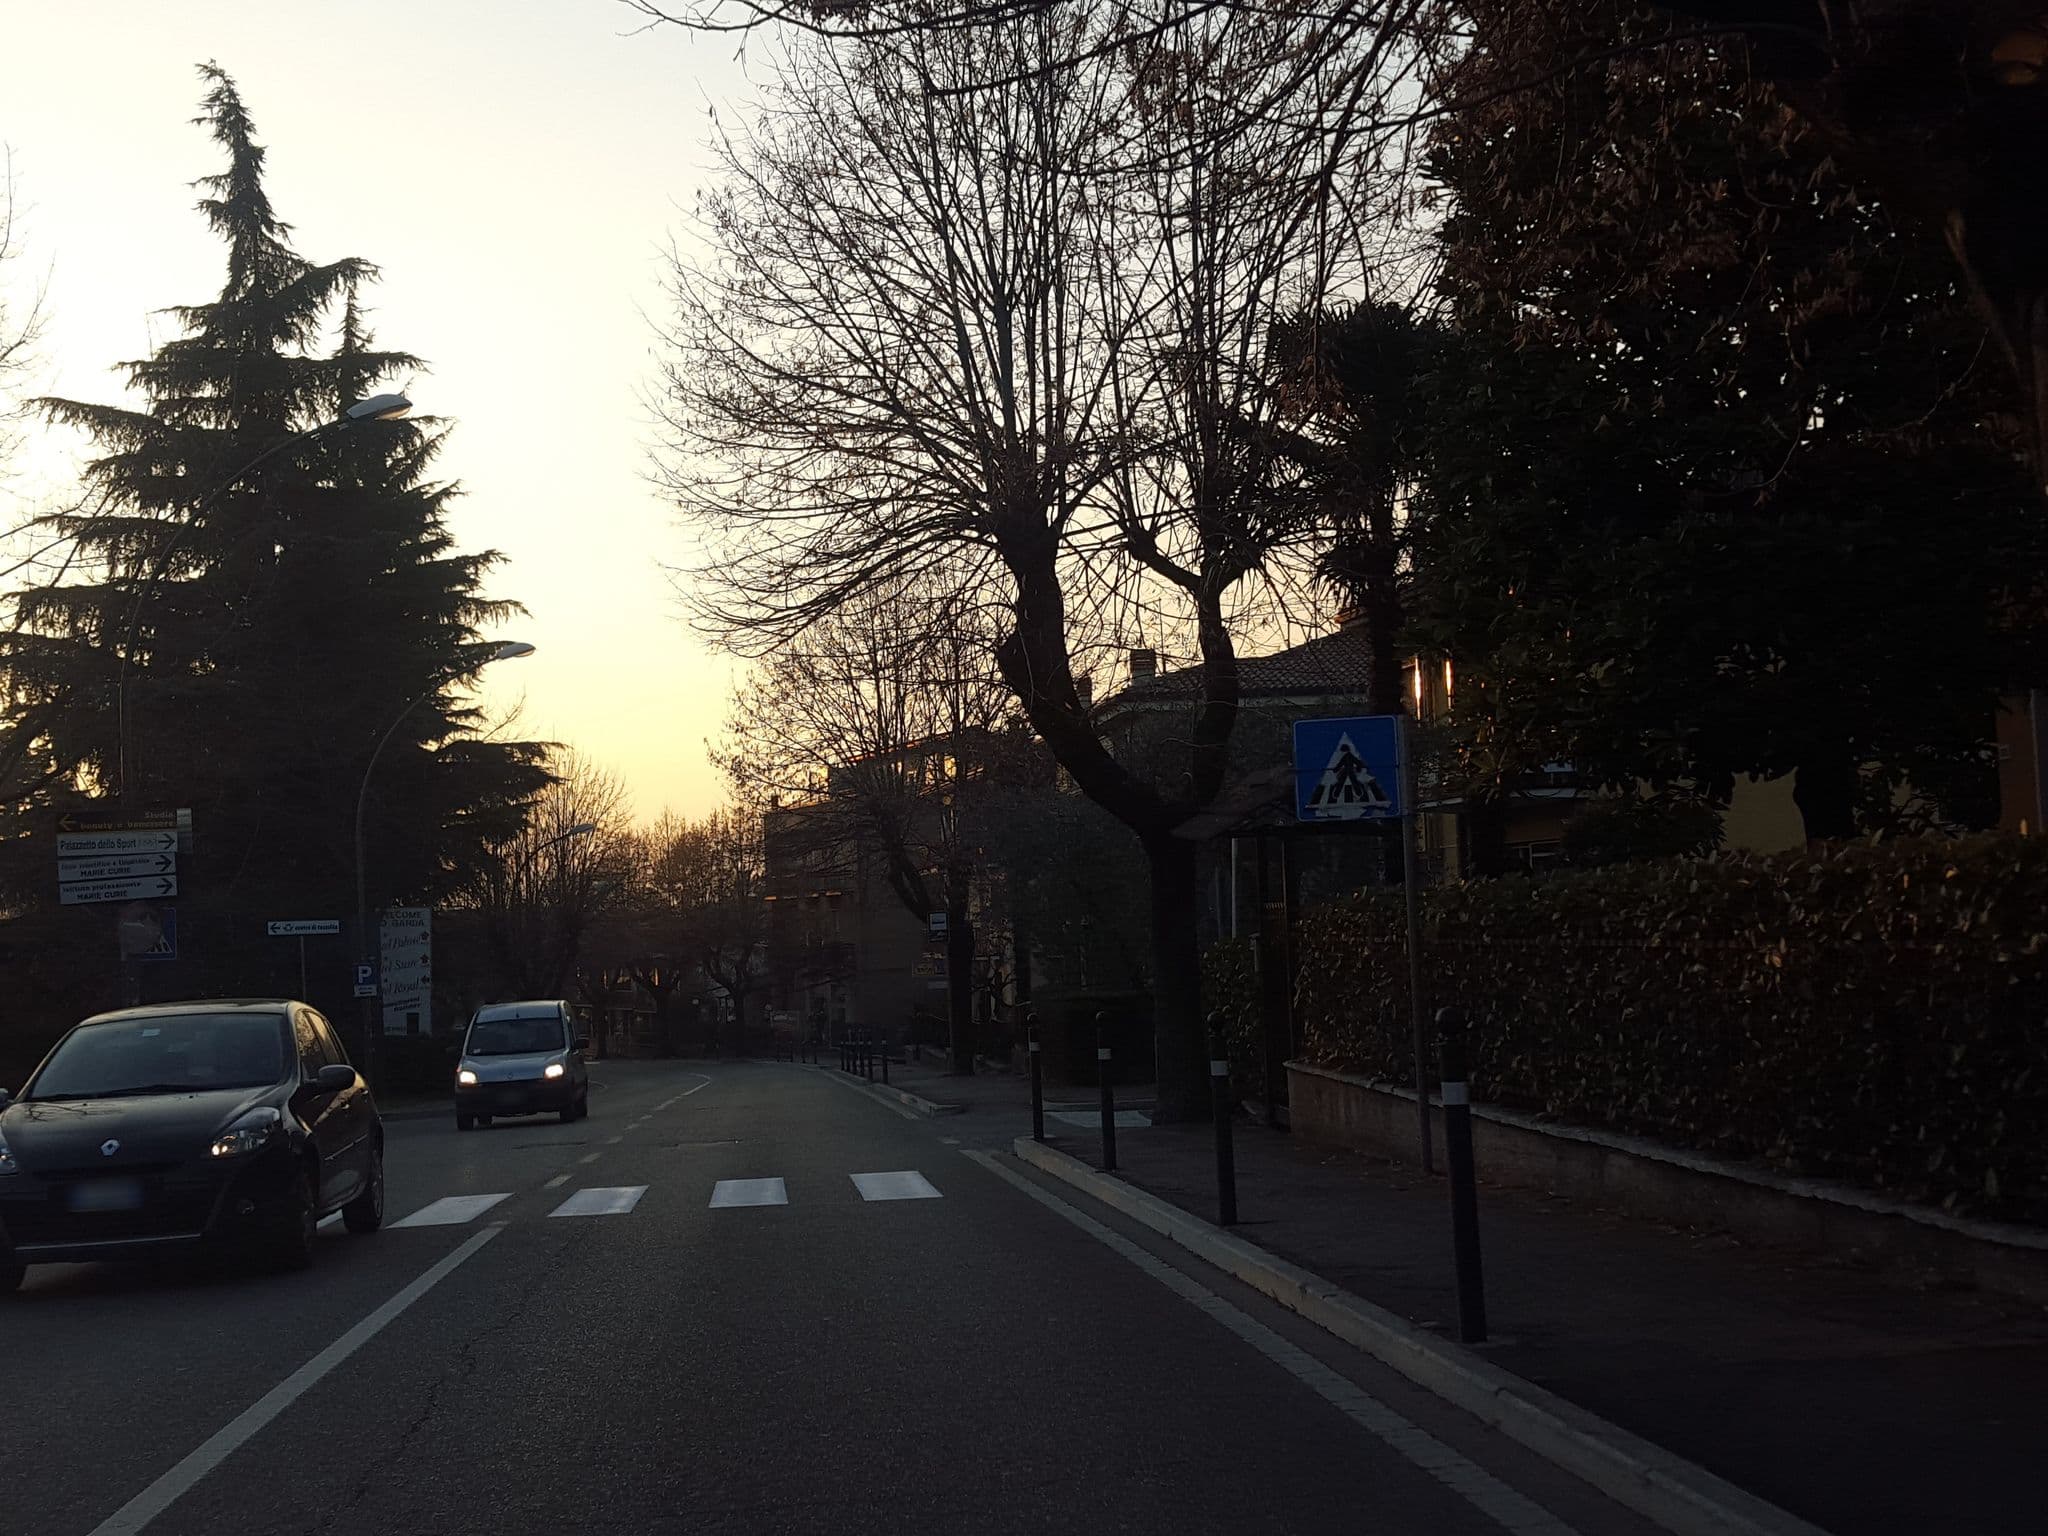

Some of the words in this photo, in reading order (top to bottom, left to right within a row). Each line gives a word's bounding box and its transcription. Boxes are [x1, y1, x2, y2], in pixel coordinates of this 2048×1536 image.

[60, 840, 97, 850] Palazzetto
[97, 839, 116, 849] dello
[116, 838, 137, 851] Sport
[80, 868, 105, 877] MARIE
[358, 965, 372, 984] P
